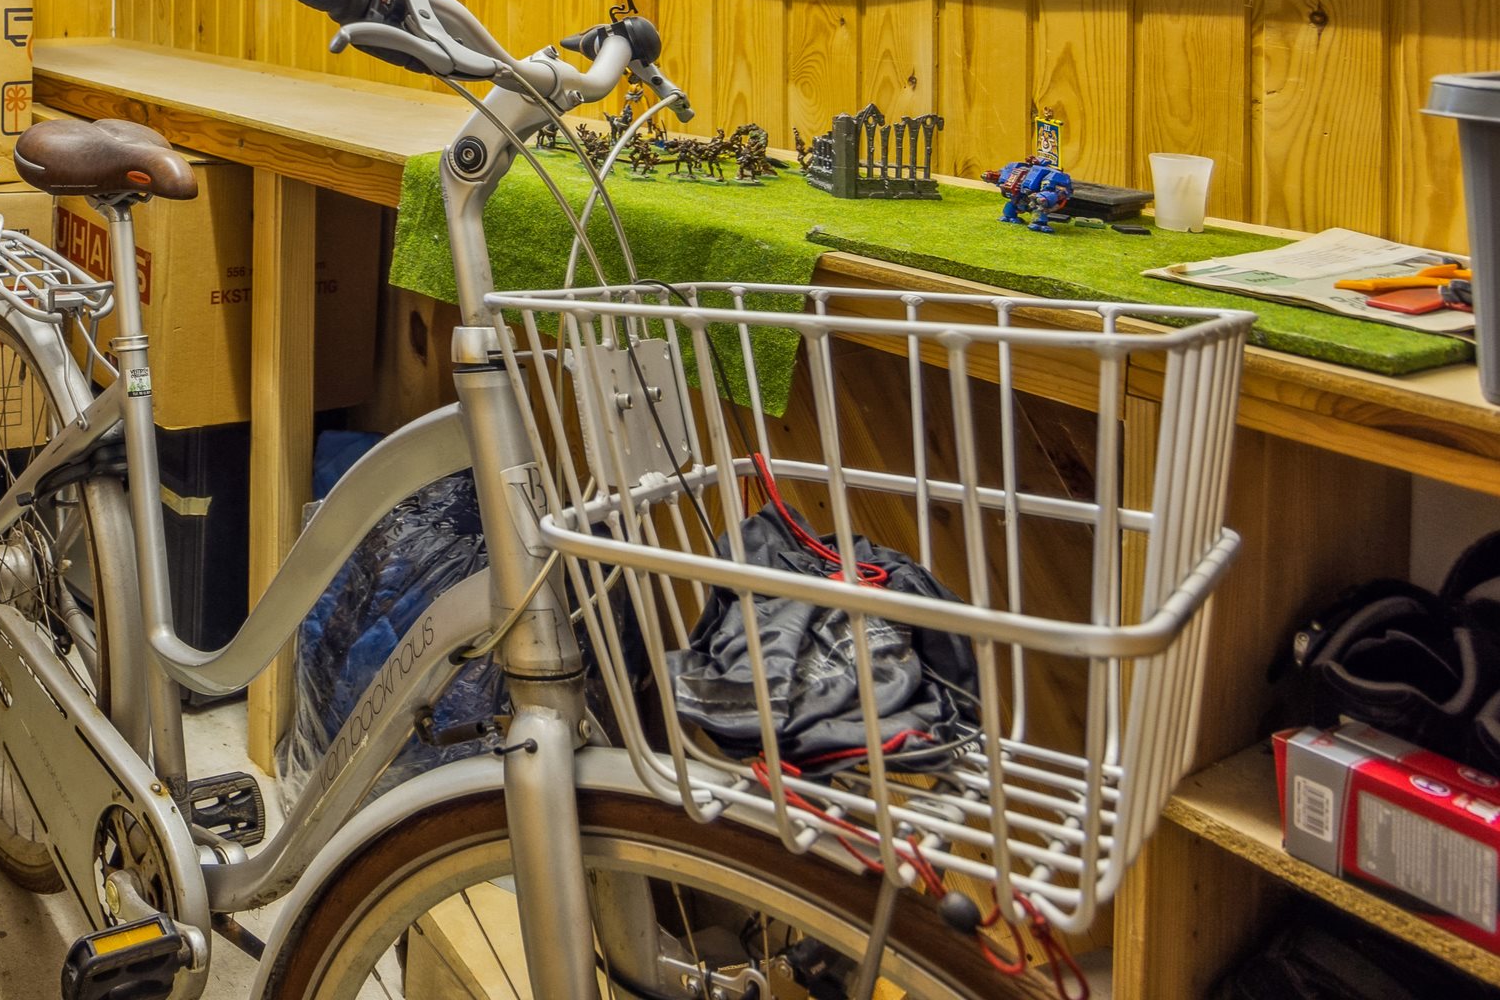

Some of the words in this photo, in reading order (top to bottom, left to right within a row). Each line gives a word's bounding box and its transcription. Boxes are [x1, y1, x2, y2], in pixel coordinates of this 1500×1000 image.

[227, 266, 246, 278] 556
[210, 287, 253, 305] EKST
[350, 616, 435, 747] backhaus
